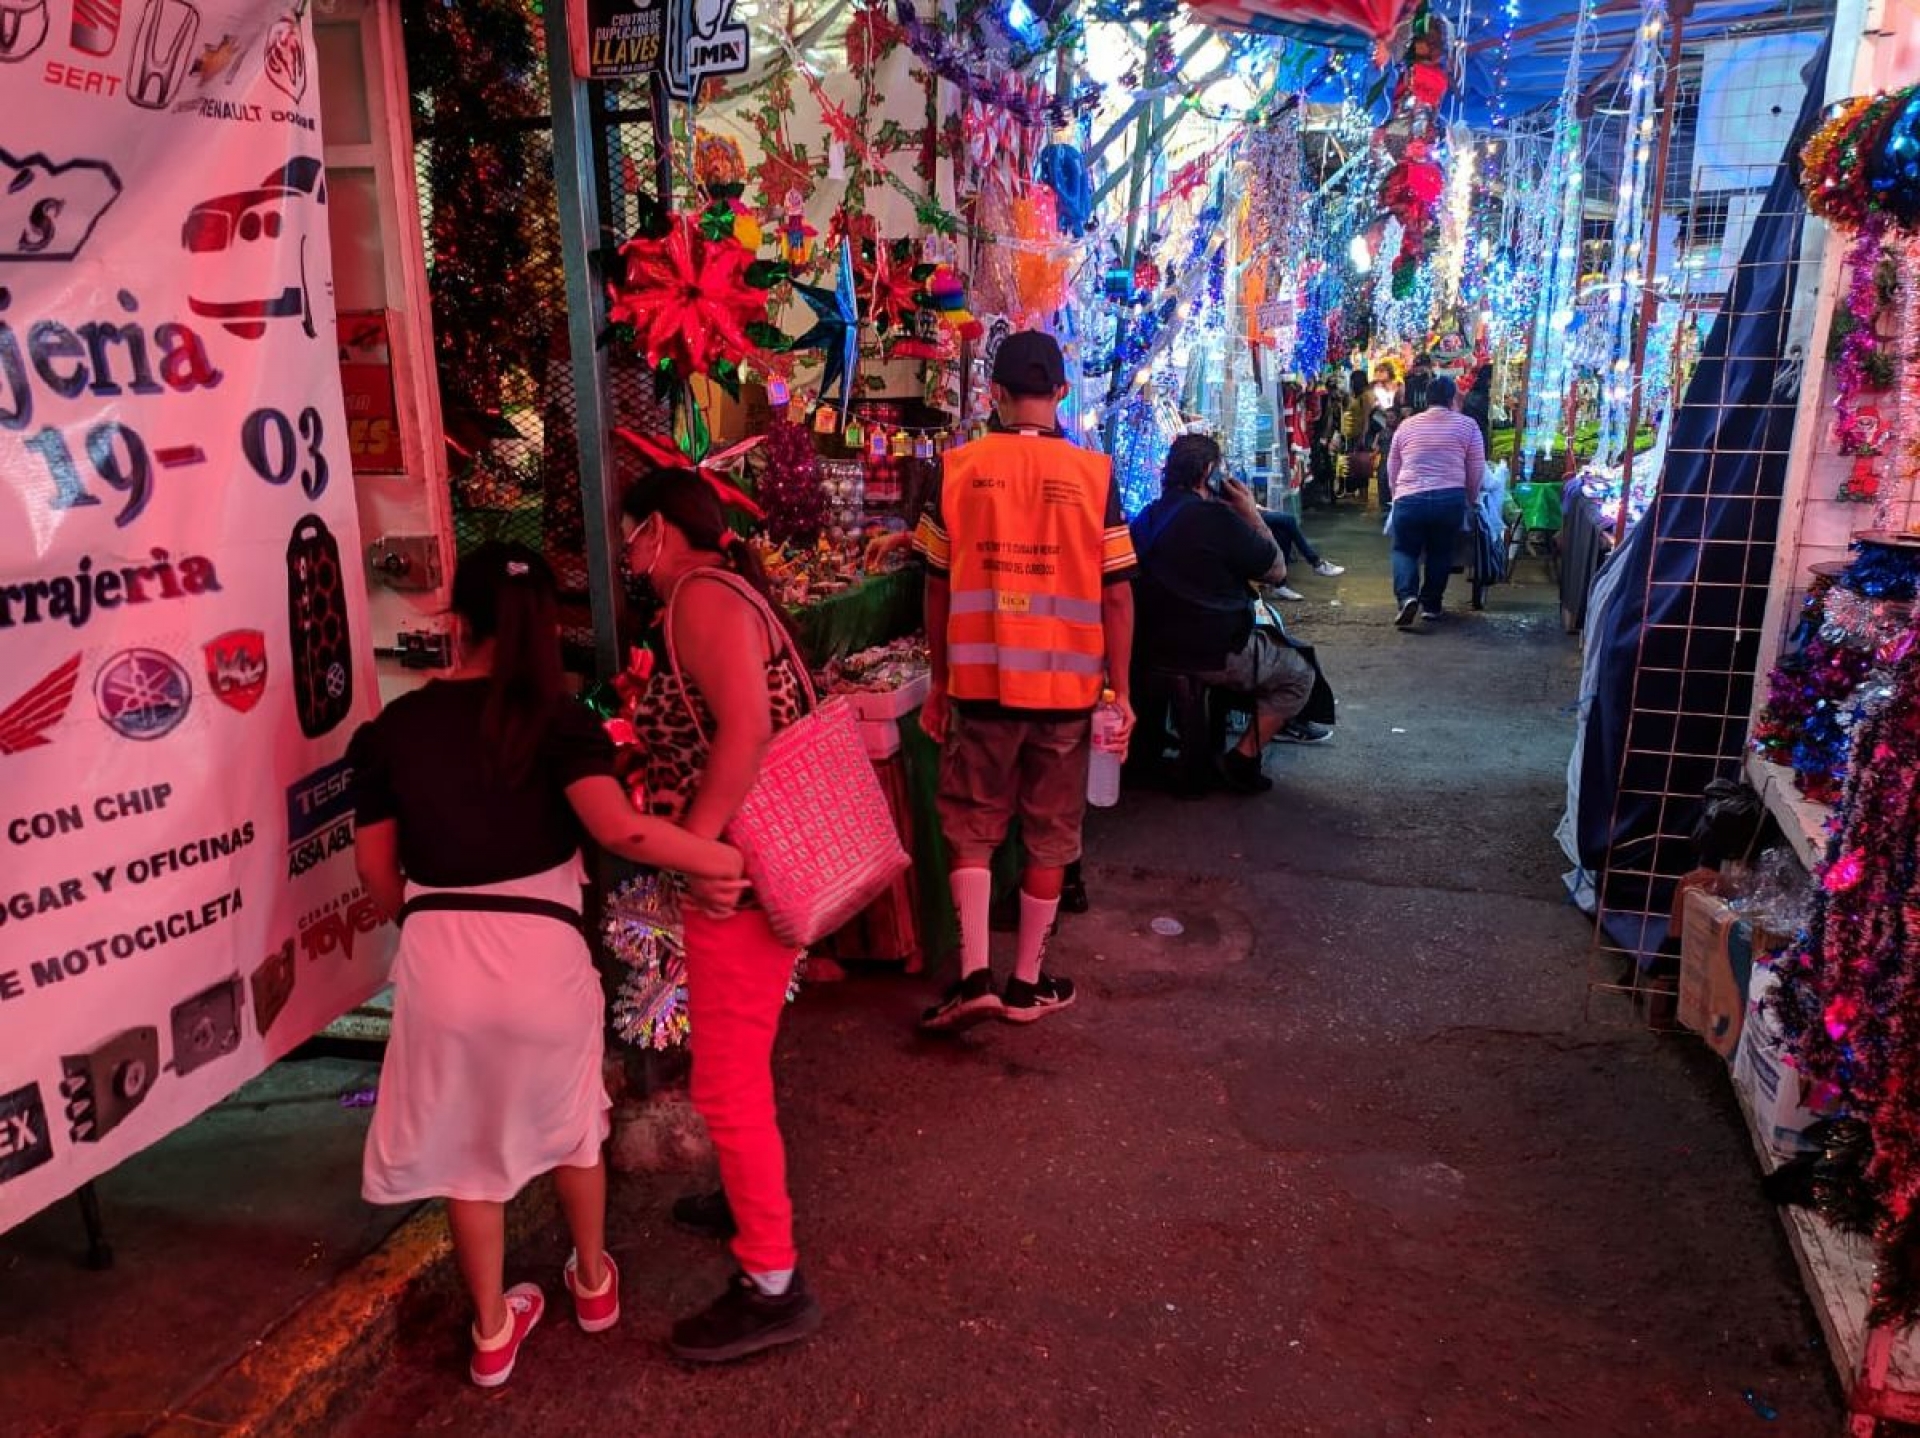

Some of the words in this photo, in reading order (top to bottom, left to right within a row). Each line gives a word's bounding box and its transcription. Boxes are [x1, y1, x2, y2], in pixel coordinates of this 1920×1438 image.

[44, 61, 122, 97] SEAT
[592, 34, 660, 65] LLAVES
[242, 407, 328, 500] 03
[8, 804, 84, 845] CON
[94, 783, 172, 823] CHIP
[93, 866, 117, 893] Y
[127, 821, 255, 885] OFICINAS
[287, 838, 326, 883] ASSA
[30, 887, 243, 987] MOTOCICLETA
